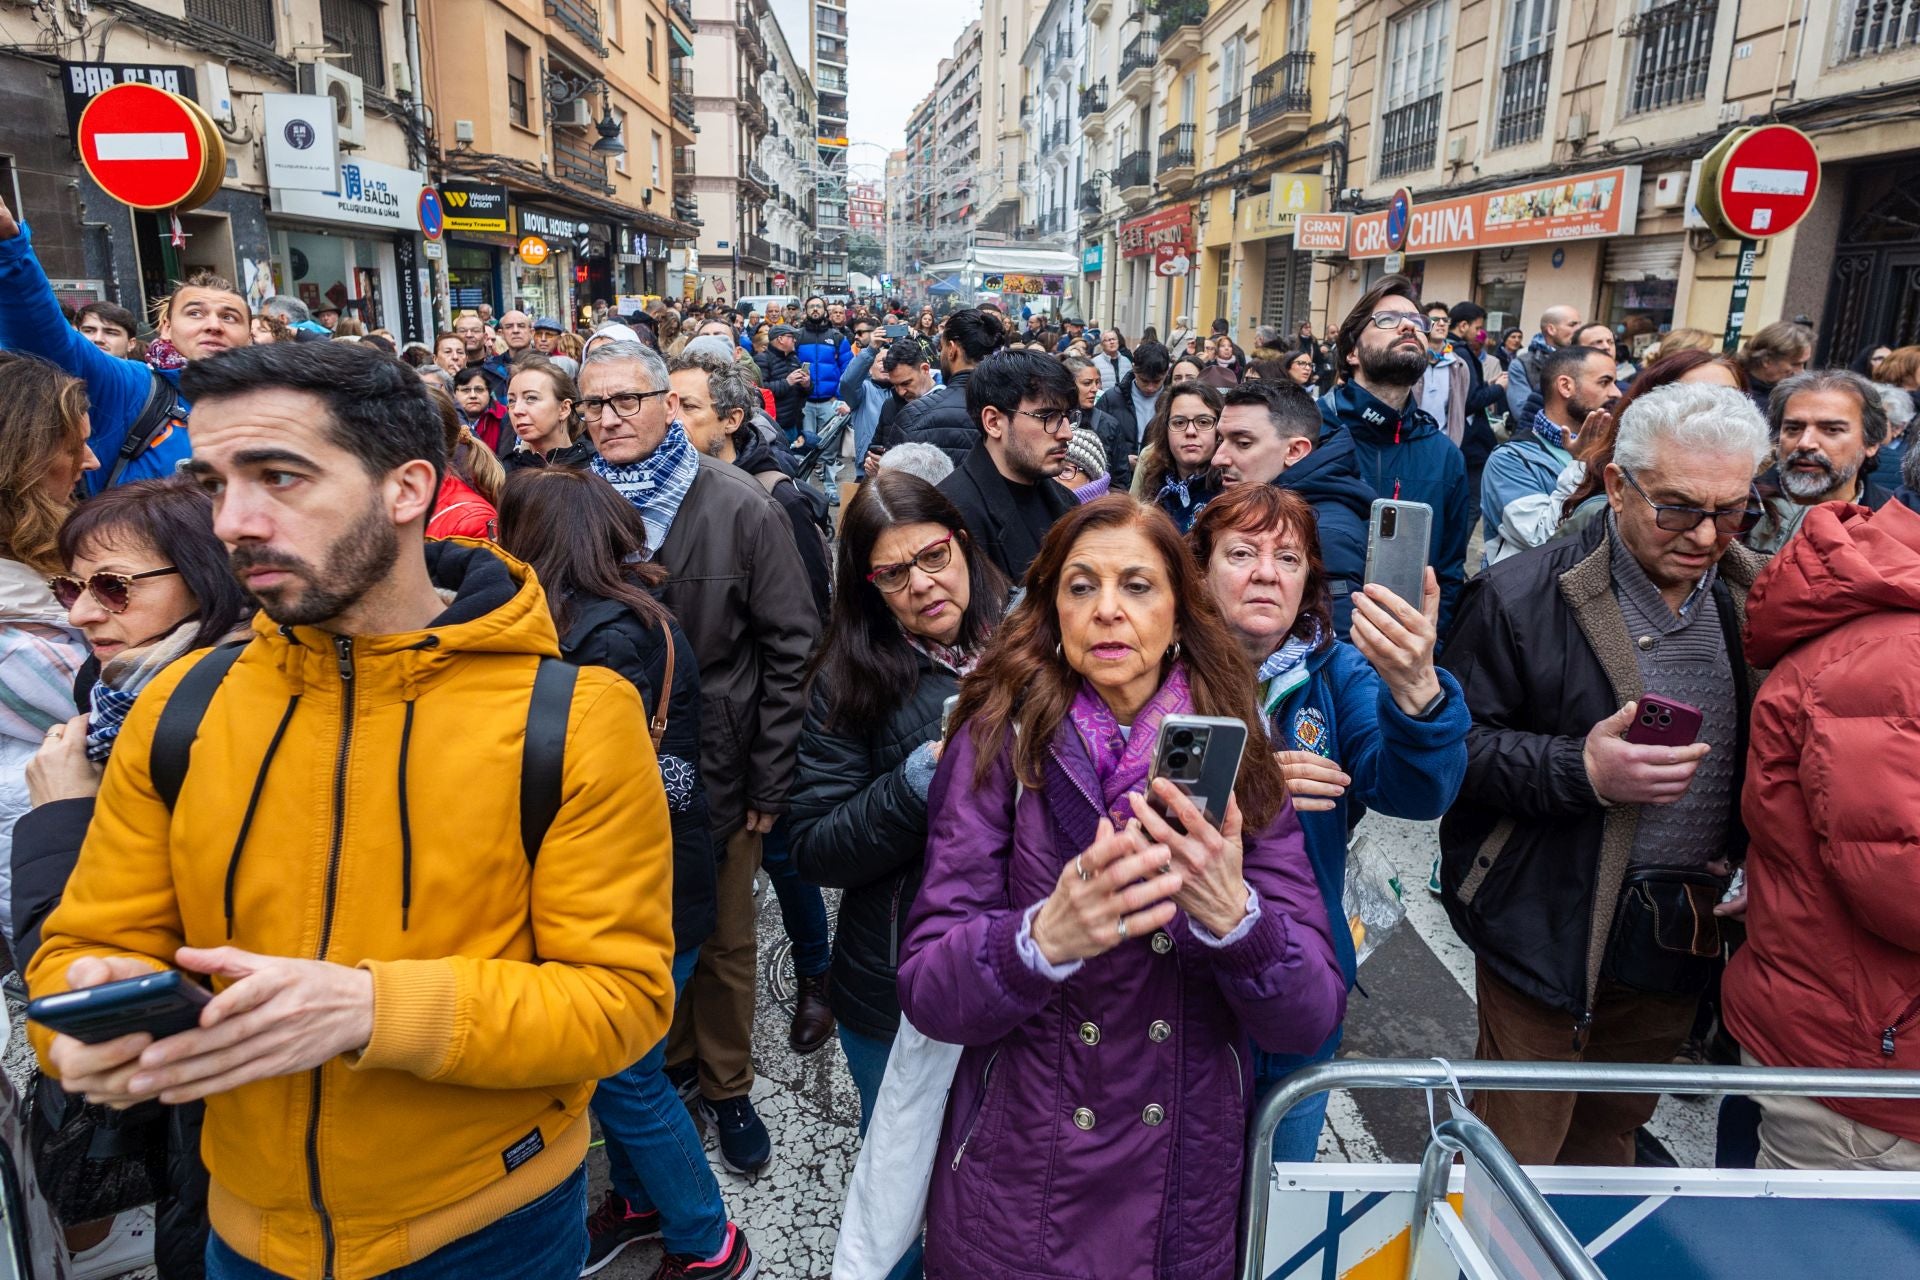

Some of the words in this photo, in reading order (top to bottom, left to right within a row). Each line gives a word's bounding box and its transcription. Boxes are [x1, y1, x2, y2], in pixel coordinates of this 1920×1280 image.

[70, 66, 115, 97] BAR
[363, 178, 375, 189] LA
[363, 189, 399, 207] SALON
[469, 192, 500, 202] Western
[469, 200, 493, 209] Union
[338, 201, 378, 216] PELUQUERIA
[378, 207, 383, 216] &
[523, 211, 549, 234] MOVIL
[549, 218, 573, 239] HOUSE
[1303, 220, 1341, 233] GRAN
[1356, 218, 1389, 252] GRA
[1408, 205, 1475, 246] CHINA
[1545, 228, 1552, 238] Y
[1552, 225, 1581, 237] MUCHO
[1302, 233, 1341, 245] CHINA
[522, 239, 544, 255] ria
[404, 269, 416, 330] PELUQUERIA
[1361, 407, 1386, 426] HH
[606, 470, 651, 483] EMT
